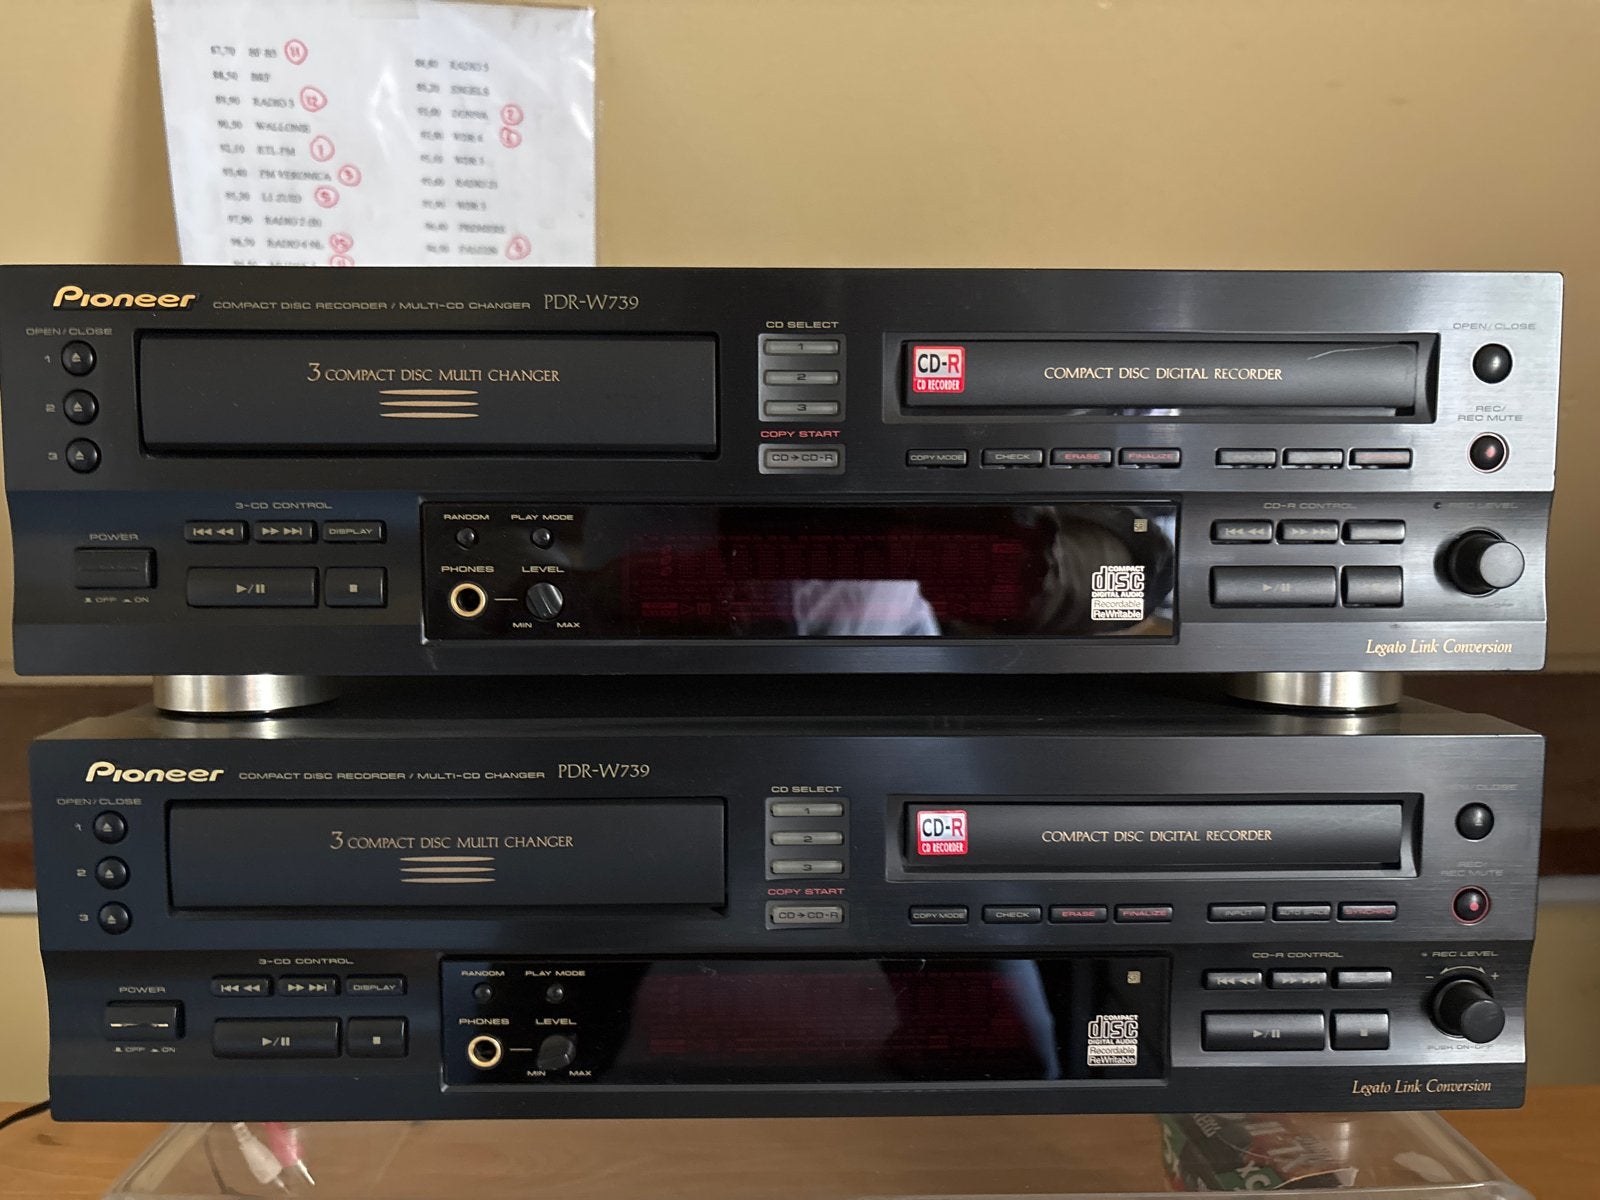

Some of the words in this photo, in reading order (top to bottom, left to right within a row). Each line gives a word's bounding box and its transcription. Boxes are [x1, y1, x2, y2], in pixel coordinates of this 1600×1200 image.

[53, 285, 196, 308] Pioneer
[213, 301, 277, 310] COMPACT
[281, 301, 311, 310] DISC
[315, 301, 388, 310] RECORDER
[399, 301, 464, 310] MULTI-CD
[469, 301, 531, 310] CHANGER
[543, 293, 640, 311] PDR-W739
[766, 321, 784, 329] CD
[787, 321, 839, 329] SELECT
[1453, 322, 1537, 331] OPEN/CLOSE
[25, 327, 113, 336] OPEN/CLOSE
[917, 353, 960, 375] CD-R
[307, 362, 321, 382] 3
[325, 369, 396, 382] COMPACT
[401, 369, 433, 382] DISC
[438, 369, 482, 382] MULTI
[488, 369, 560, 383] CHANGER
[797, 373, 807, 381] 2
[1044, 367, 1114, 380] COMPACT
[1118, 367, 1150, 380] DISC
[1156, 367, 1208, 380] DIGITAL
[1214, 367, 1283, 381] RECORDER
[916, 379, 927, 391] CD
[927, 379, 961, 391] RECORDER
[45, 404, 56, 413] 2
[797, 403, 807, 412] 3
[1475, 404, 1505, 413] REC/
[1457, 414, 1484, 422] REC
[1486, 414, 1523, 422] MUTE
[760, 430, 795, 439] COPY
[799, 430, 841, 439] START
[48, 452, 58, 461] 3
[772, 454, 789, 462] CD
[801, 454, 834, 462] CD-R
[235, 502, 269, 510] 3-CD
[272, 502, 333, 510] CONTROL
[1263, 502, 1296, 510] CD-R
[1299, 502, 1358, 510] CONTROL
[89, 533, 139, 541] POWER
[441, 565, 495, 573] PHONES
[521, 565, 565, 573] LEVEL
[1093, 599, 1141, 608] Recordable
[1093, 610, 1142, 619] ReWritable
[1366, 638, 1406, 656] Legato
[1410, 638, 1439, 654] Link
[1442, 638, 1513, 654] Conversion
[85, 761, 225, 783] Pioneer
[557, 763, 650, 779] PDR-W739
[239, 772, 300, 780] COMPACT
[303, 772, 333, 780] DISC
[337, 772, 406, 780] RECORDER
[417, 772, 481, 780] MULTI-CD
[484, 772, 545, 780] CHANGER
[771, 785, 789, 793] CD
[791, 785, 842, 793] SELECT
[56, 798, 142, 806] OPEN/CLOSE
[922, 818, 963, 837] CD-R
[330, 831, 344, 850] 3
[347, 837, 415, 849] COMPACT
[420, 837, 451, 849] DISC
[457, 837, 499, 849] MULTI
[504, 836, 574, 849] CHANGER
[803, 835, 813, 843] 2
[1042, 830, 1109, 843] COMPACT
[1113, 830, 1145, 843] DISC
[1149, 830, 1201, 843] DIGITAL
[1206, 830, 1272, 842] RECORDER
[922, 842, 932, 853] CD
[932, 842, 964, 853] RECORDER
[76, 868, 87, 877] 2
[803, 864, 813, 872] 3
[767, 888, 801, 896] COPY
[804, 888, 846, 896] START
[79, 913, 89, 922] 3
[778, 911, 796, 919] CD
[806, 911, 839, 919] CD-R
[258, 958, 291, 966] 3-CD
[295, 958, 354, 966] CONTROL
[119, 986, 166, 994] POWER
[1089, 1047, 1135, 1055] Recordable
[1089, 1056, 1136, 1065] ReWritable
[1352, 1079, 1391, 1097] Legato
[1394, 1079, 1421, 1094] Link
[1425, 1078, 1492, 1093] Conversion
